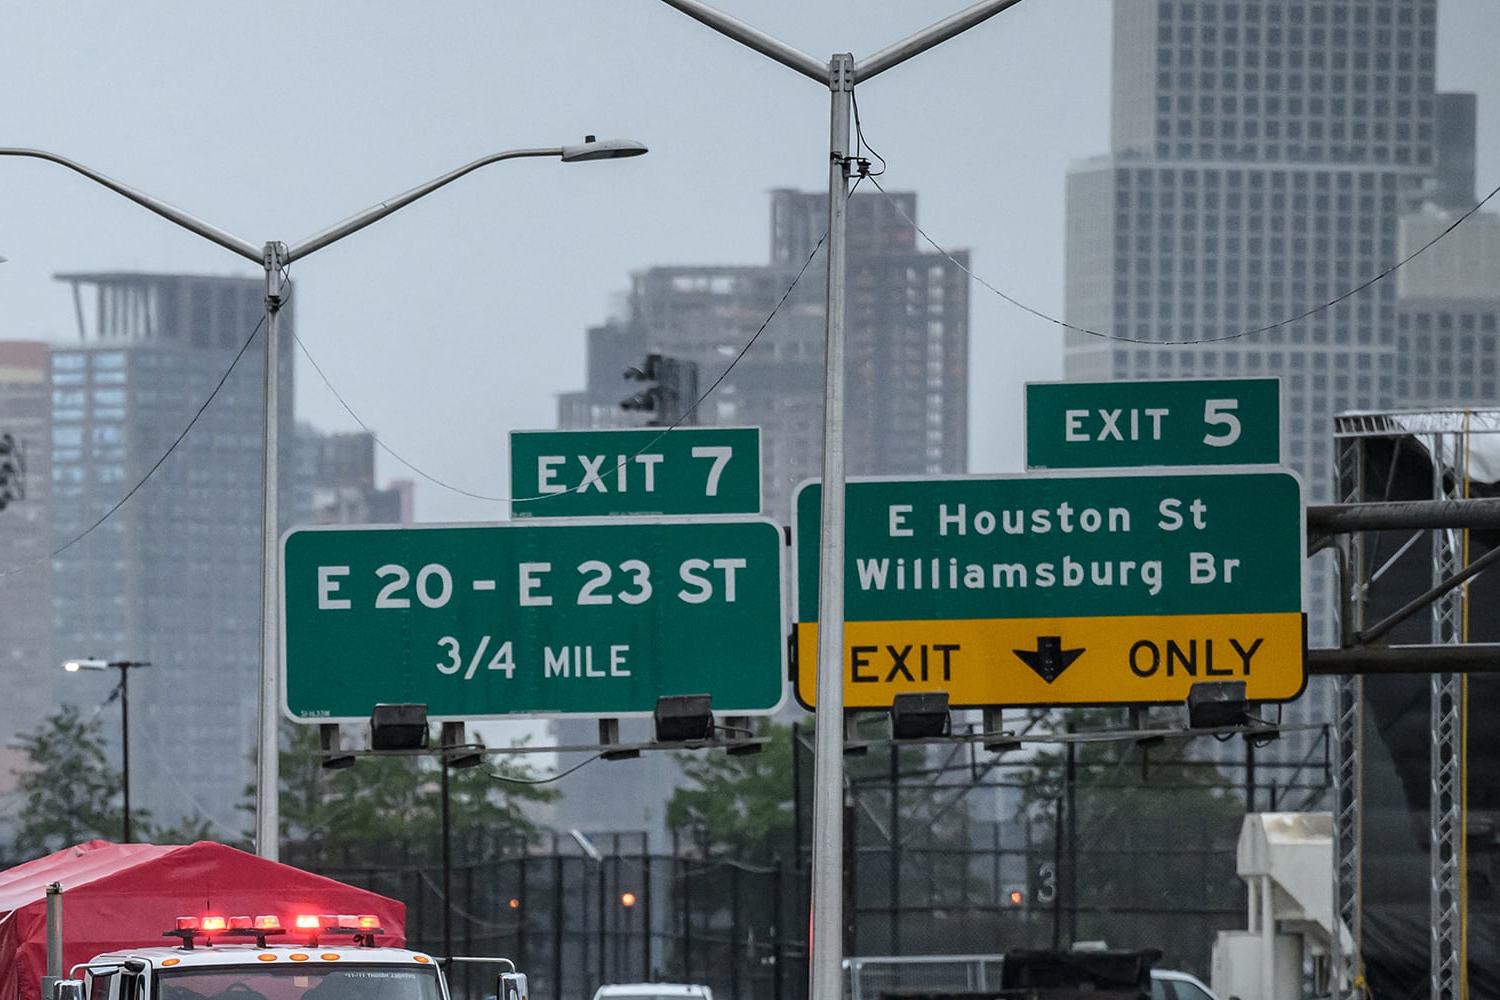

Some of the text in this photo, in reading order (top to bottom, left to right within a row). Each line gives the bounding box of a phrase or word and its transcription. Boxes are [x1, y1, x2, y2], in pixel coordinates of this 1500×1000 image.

[1065, 399, 1241, 447] EXIT 5
[538, 446, 733, 497] EXIT 7
[889, 498, 1207, 537] E Houston St
[317, 565, 352, 610] E
[375, 563, 453, 609] 20
[519, 562, 553, 607] E
[577, 559, 653, 605] 23
[677, 558, 747, 604] ST
[856, 552, 1240, 596] Williamsburg Br
[436, 635, 631, 680] 3/4 MILE
[850, 637, 1265, 684] EXIT ONLY
